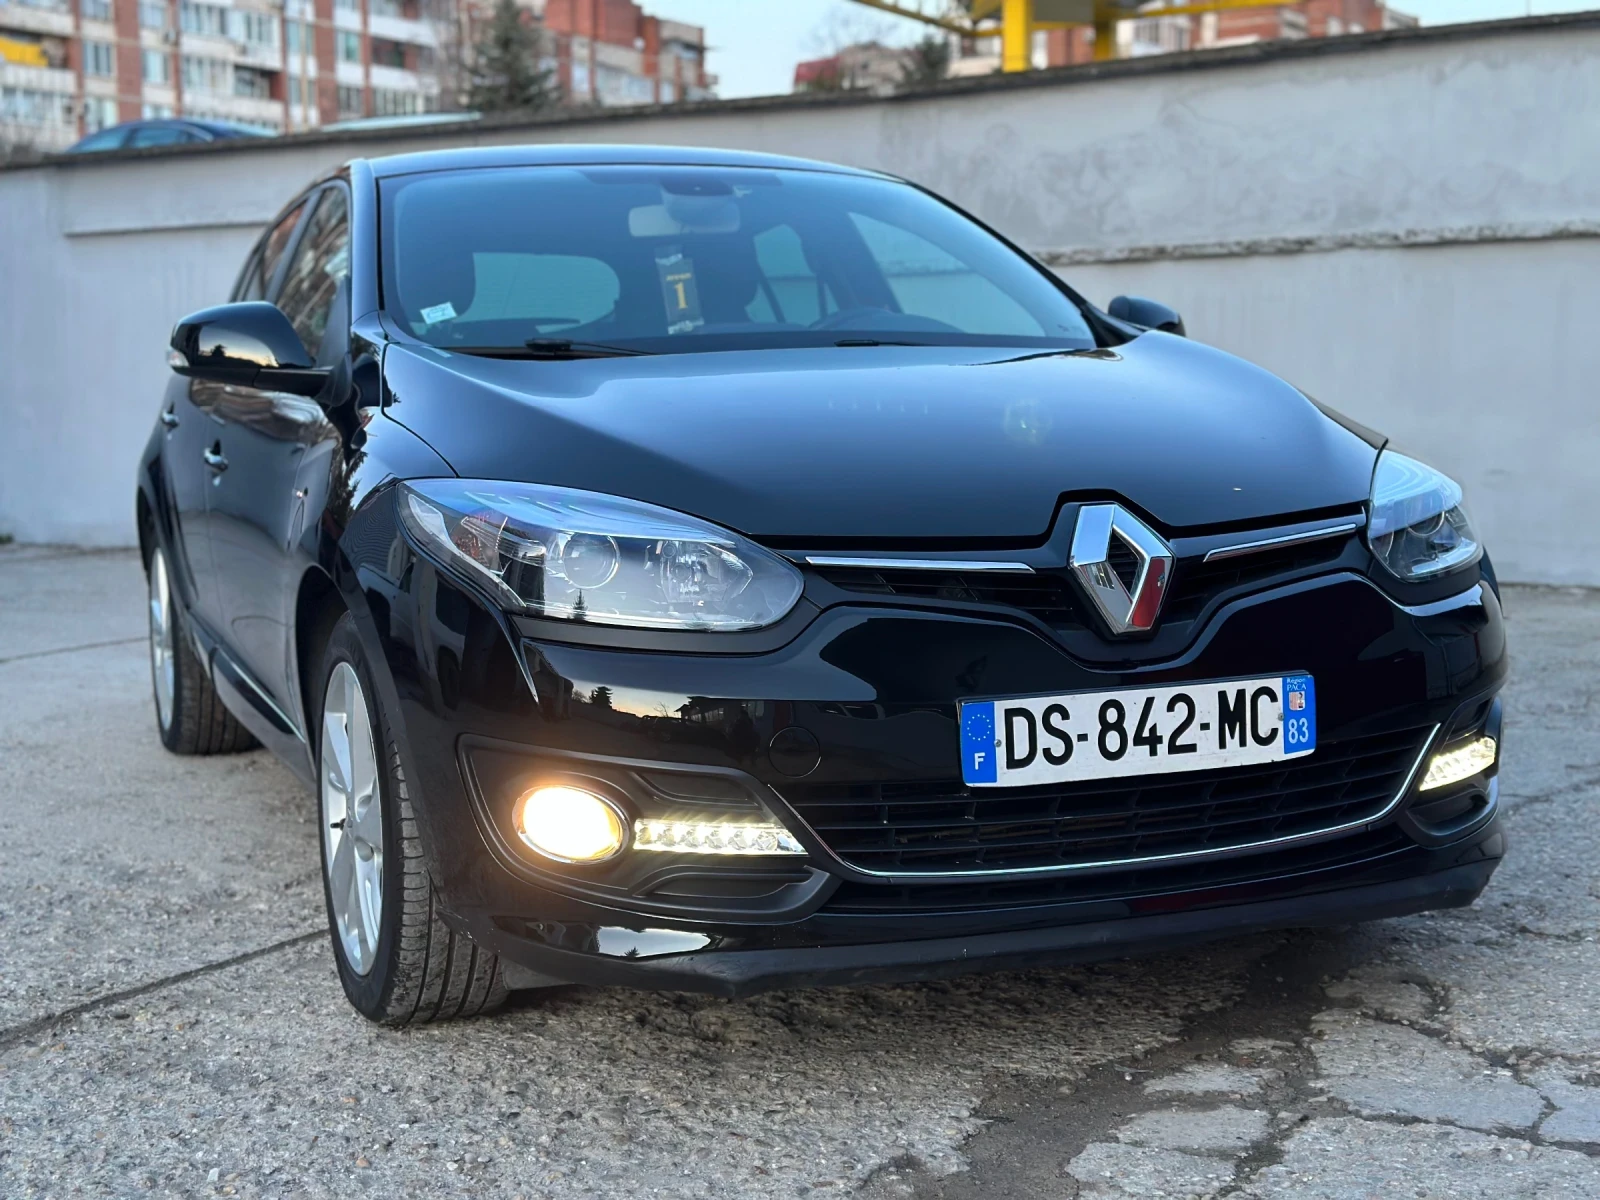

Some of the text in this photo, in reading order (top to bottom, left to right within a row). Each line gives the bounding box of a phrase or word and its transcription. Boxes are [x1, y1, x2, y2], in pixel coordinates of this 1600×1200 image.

[1286, 683, 1307, 692] PACA
[1004, 686, 1279, 770] DS-842-MC
[1288, 717, 1309, 744] 83
[974, 752, 986, 770] F
